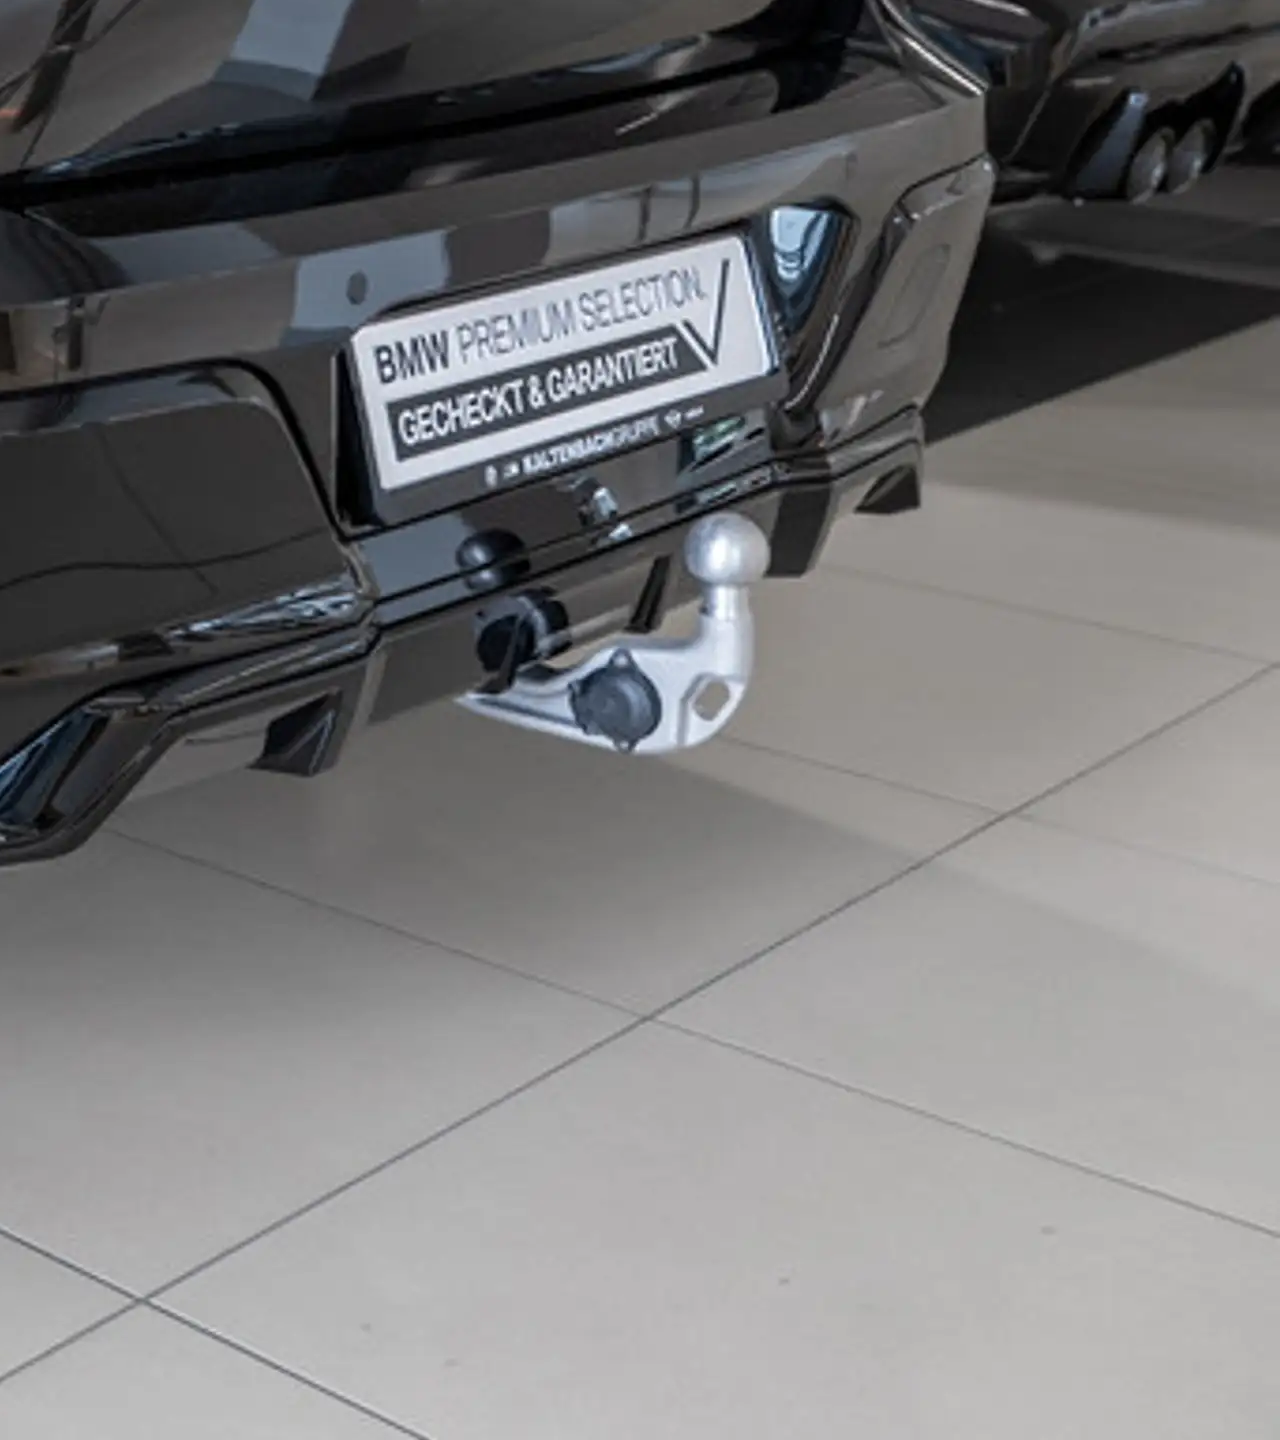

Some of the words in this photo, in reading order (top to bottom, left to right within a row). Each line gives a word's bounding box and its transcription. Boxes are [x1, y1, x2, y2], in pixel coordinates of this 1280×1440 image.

[374, 329, 450, 385] BMW
[458, 297, 577, 363] PREMIUM
[397, 382, 526, 445] GECHECKT
[529, 376, 546, 406] &
[547, 337, 680, 402] GARANTIERT
